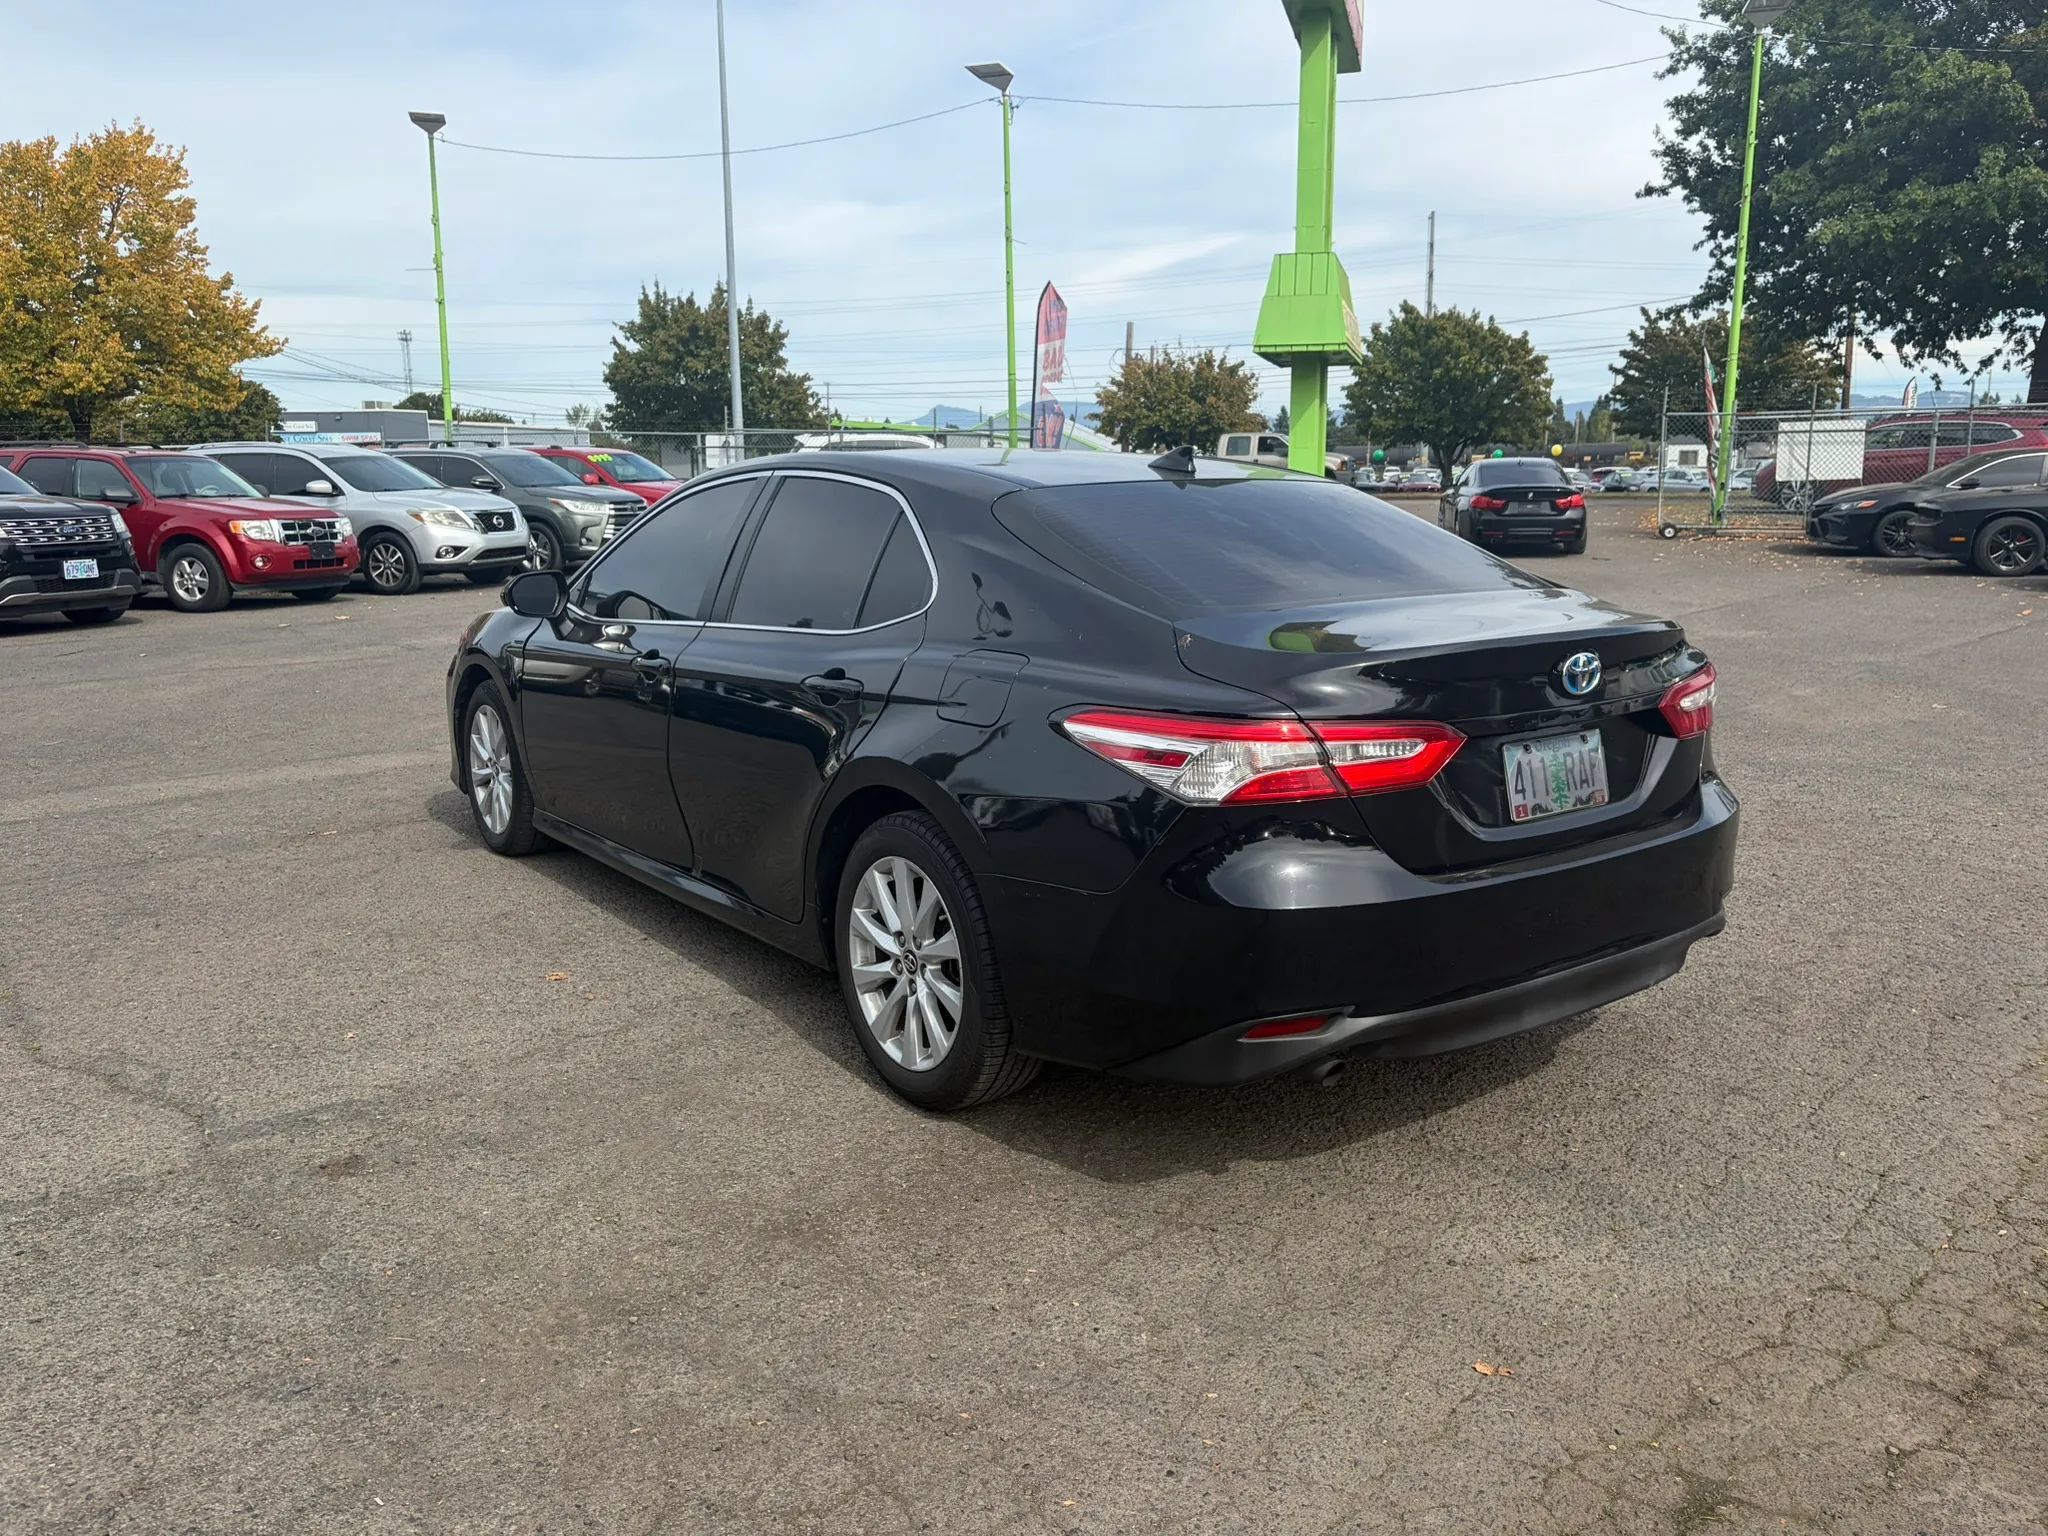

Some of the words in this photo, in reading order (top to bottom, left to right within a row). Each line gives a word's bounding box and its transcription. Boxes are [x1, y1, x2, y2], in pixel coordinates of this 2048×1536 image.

[66, 564, 80, 576] 679
[1535, 738, 1570, 753] Oregon
[1514, 756, 1549, 801] 411
